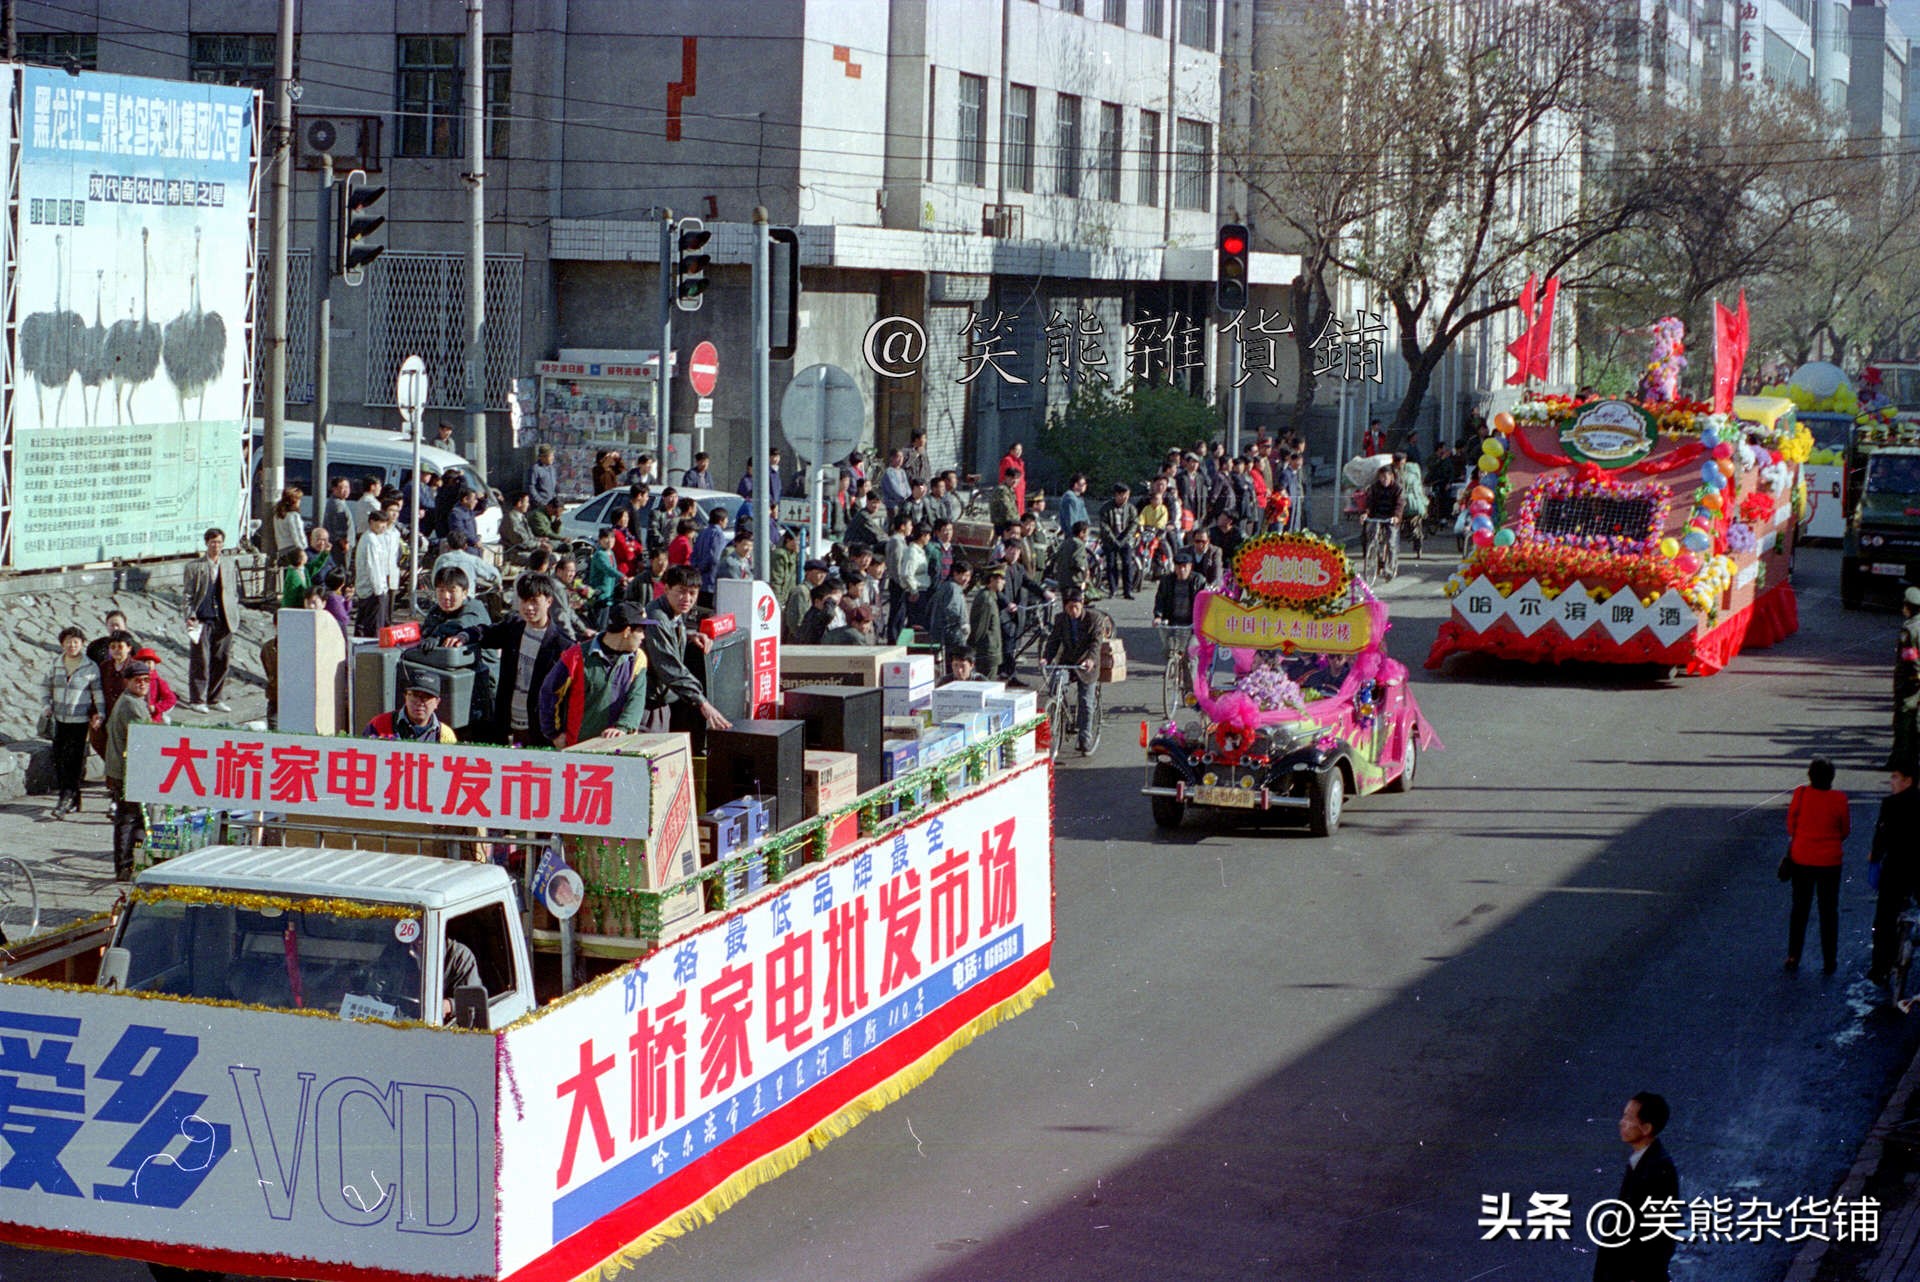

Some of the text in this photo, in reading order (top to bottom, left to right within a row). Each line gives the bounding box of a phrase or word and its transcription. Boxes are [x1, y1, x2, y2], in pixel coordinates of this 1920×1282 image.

[89, 174, 225, 207] 现代畜牧业希望之星
[1226, 615, 1351, 642] 中国十大杰出影楼
[1469, 595, 1681, 626] 哈尔滨啤酒
[158, 737, 615, 826] 大桥家电批发市场
[399, 923, 415, 936] 26
[623, 817, 944, 1015] 价格最低品牌最全
[556, 816, 1017, 1190] 大桥家电批发市场
[0, 1010, 481, 1237] 爱多 VCD
